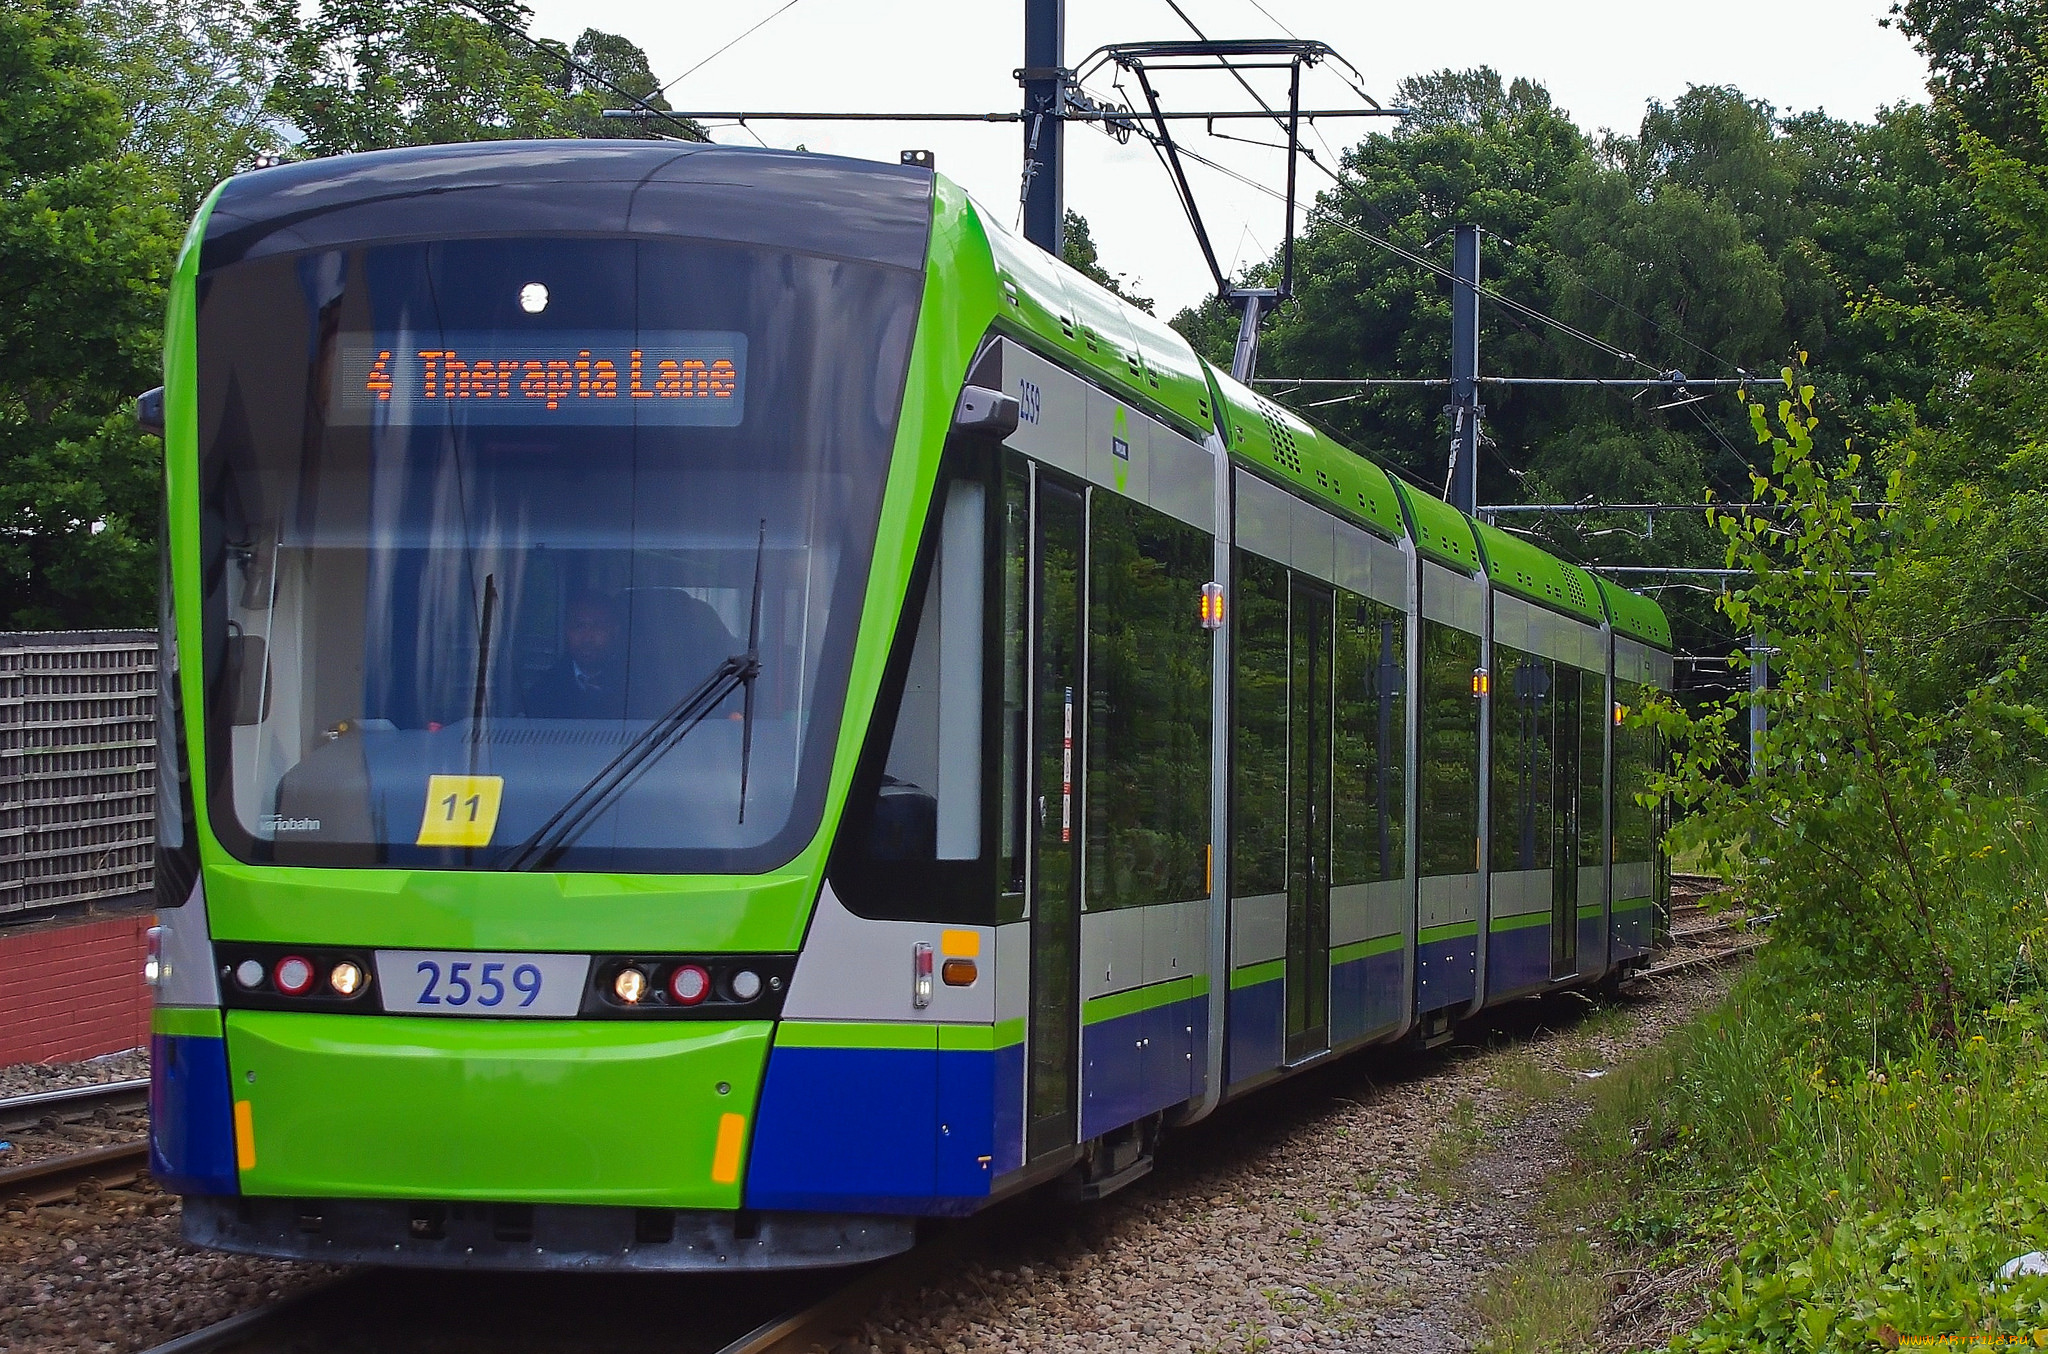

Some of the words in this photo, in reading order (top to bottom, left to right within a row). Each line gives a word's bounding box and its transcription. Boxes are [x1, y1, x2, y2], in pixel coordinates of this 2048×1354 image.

[366, 350, 394, 400] 4
[417, 350, 618, 410] Therapia
[630, 350, 736, 397] Lane
[1020, 379, 1041, 425] 2559
[441, 793, 481, 822] 11
[416, 960, 543, 1007] 2559
